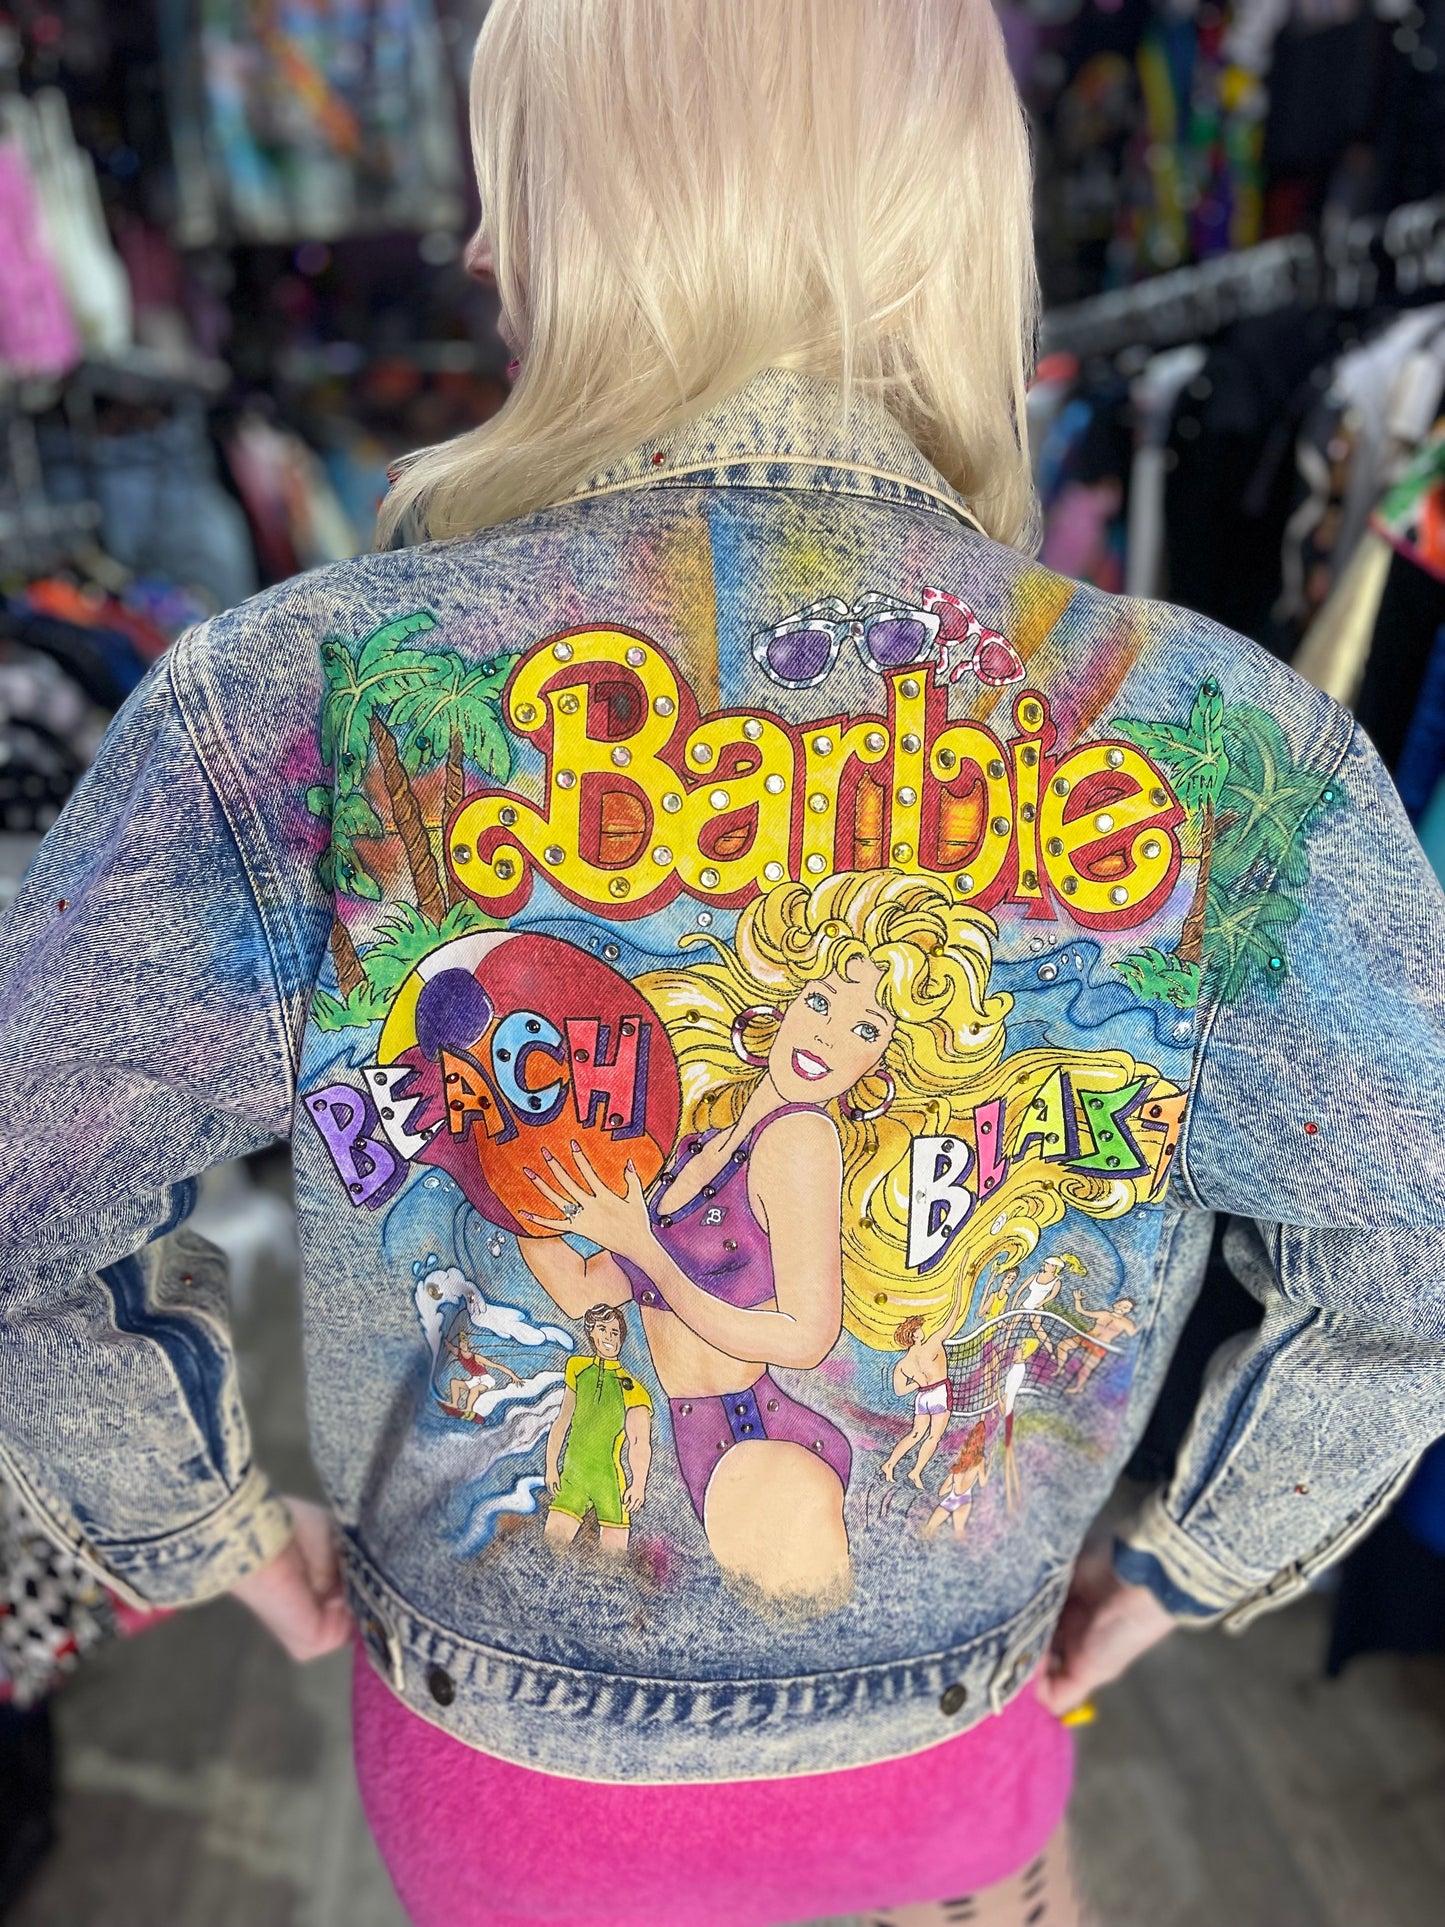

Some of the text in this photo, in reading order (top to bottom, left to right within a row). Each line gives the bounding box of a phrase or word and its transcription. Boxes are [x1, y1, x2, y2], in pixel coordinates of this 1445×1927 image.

[447, 622, 1213, 932] Barbie TM
[303, 1011, 650, 1210] BEACH
[706, 1208, 722, 1225] B
